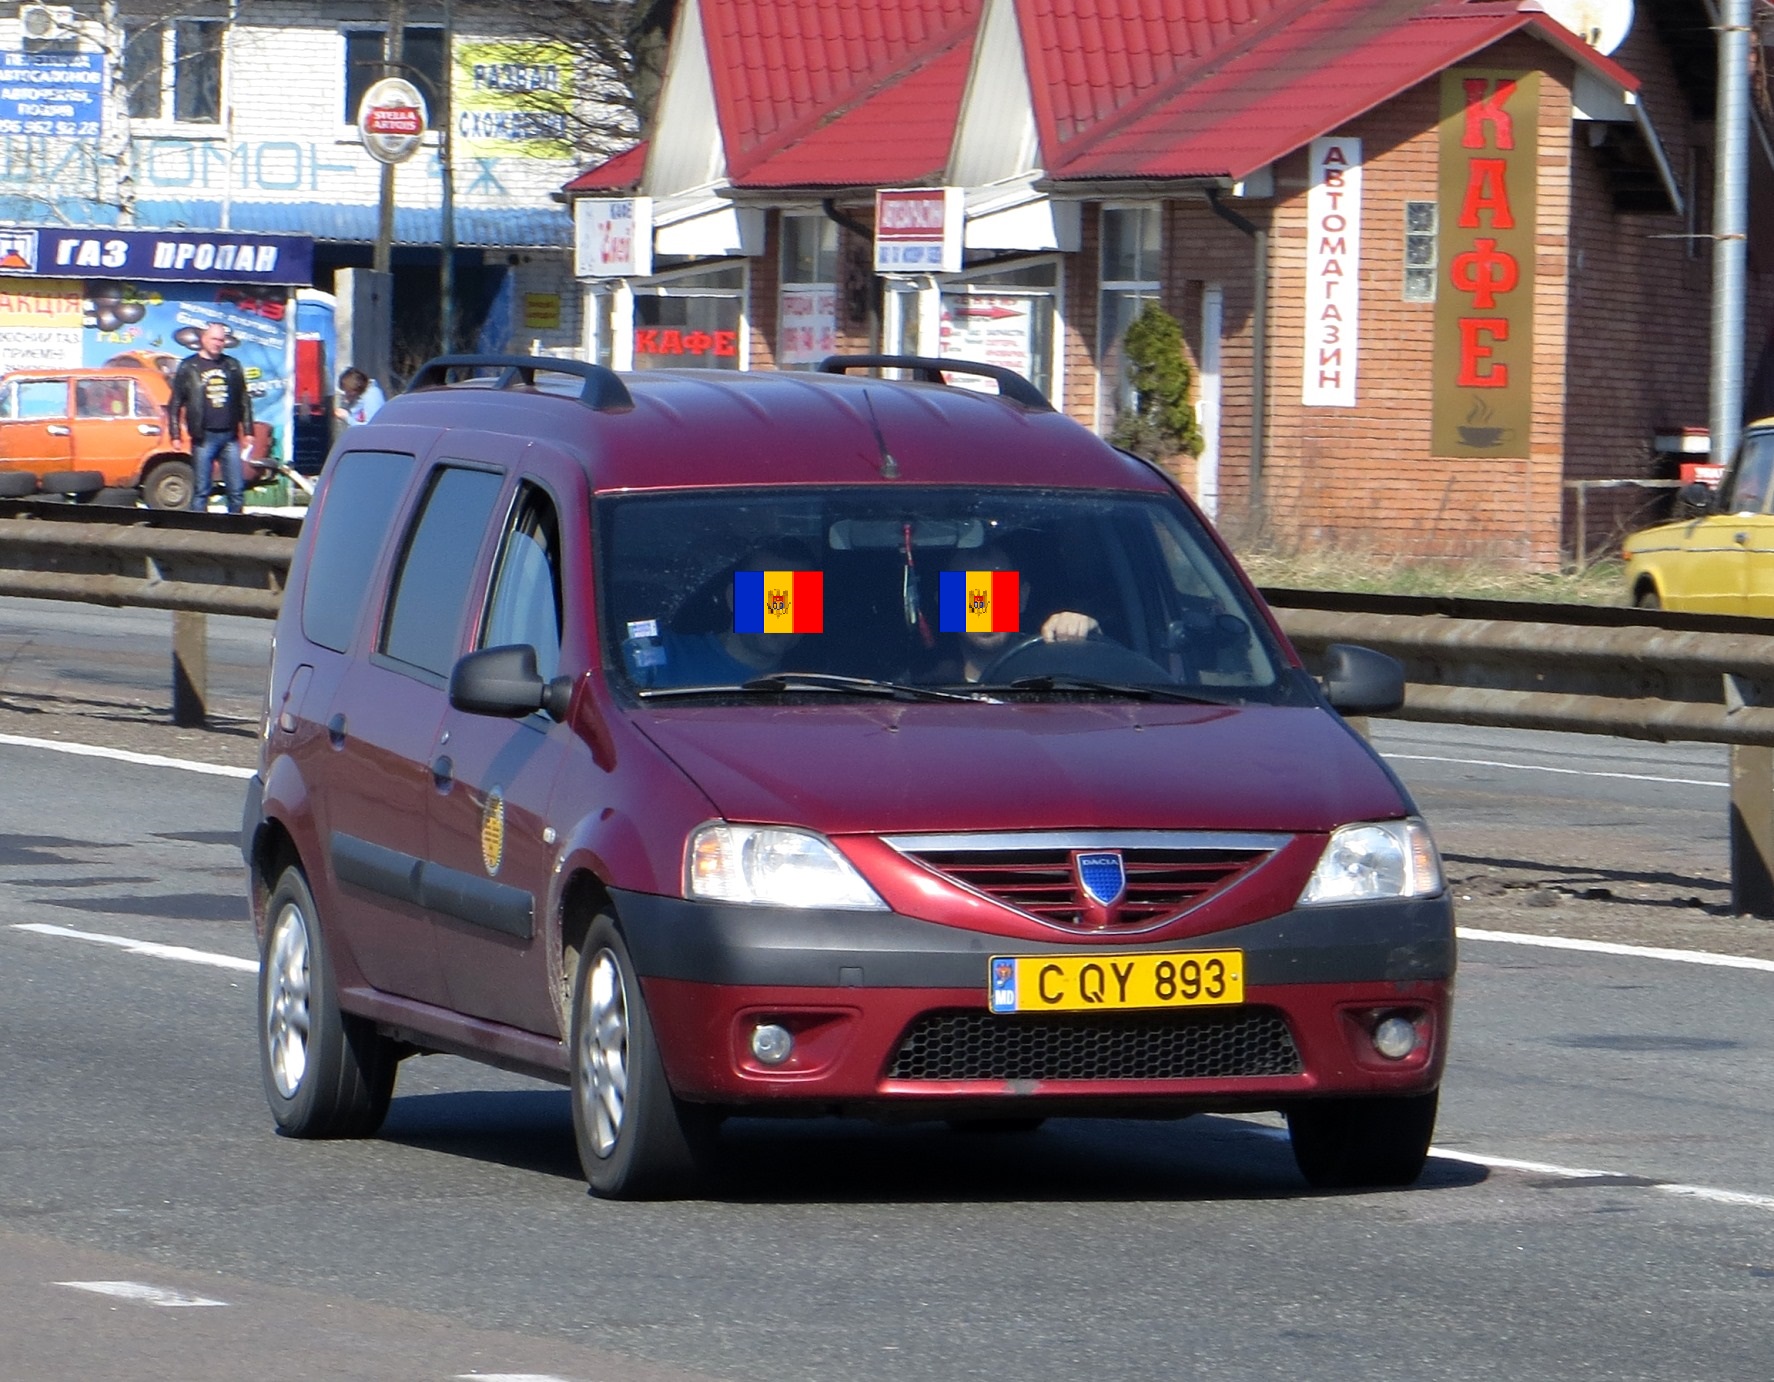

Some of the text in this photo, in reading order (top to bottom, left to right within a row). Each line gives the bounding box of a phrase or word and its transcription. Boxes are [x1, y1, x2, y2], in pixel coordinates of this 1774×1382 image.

[374, 110, 416, 120] STELLA
[1450, 79, 1519, 388] КАФЕ
[56, 239, 278, 272] ГАЗ ПРОПАН
[1318, 146, 1349, 389] АВТОМАГАЗИН
[635, 328, 737, 357] КАФЕ
[1081, 858, 1119, 866] DACIA
[1038, 958, 1226, 1004] C QY 893
[994, 989, 1015, 1006] MD
